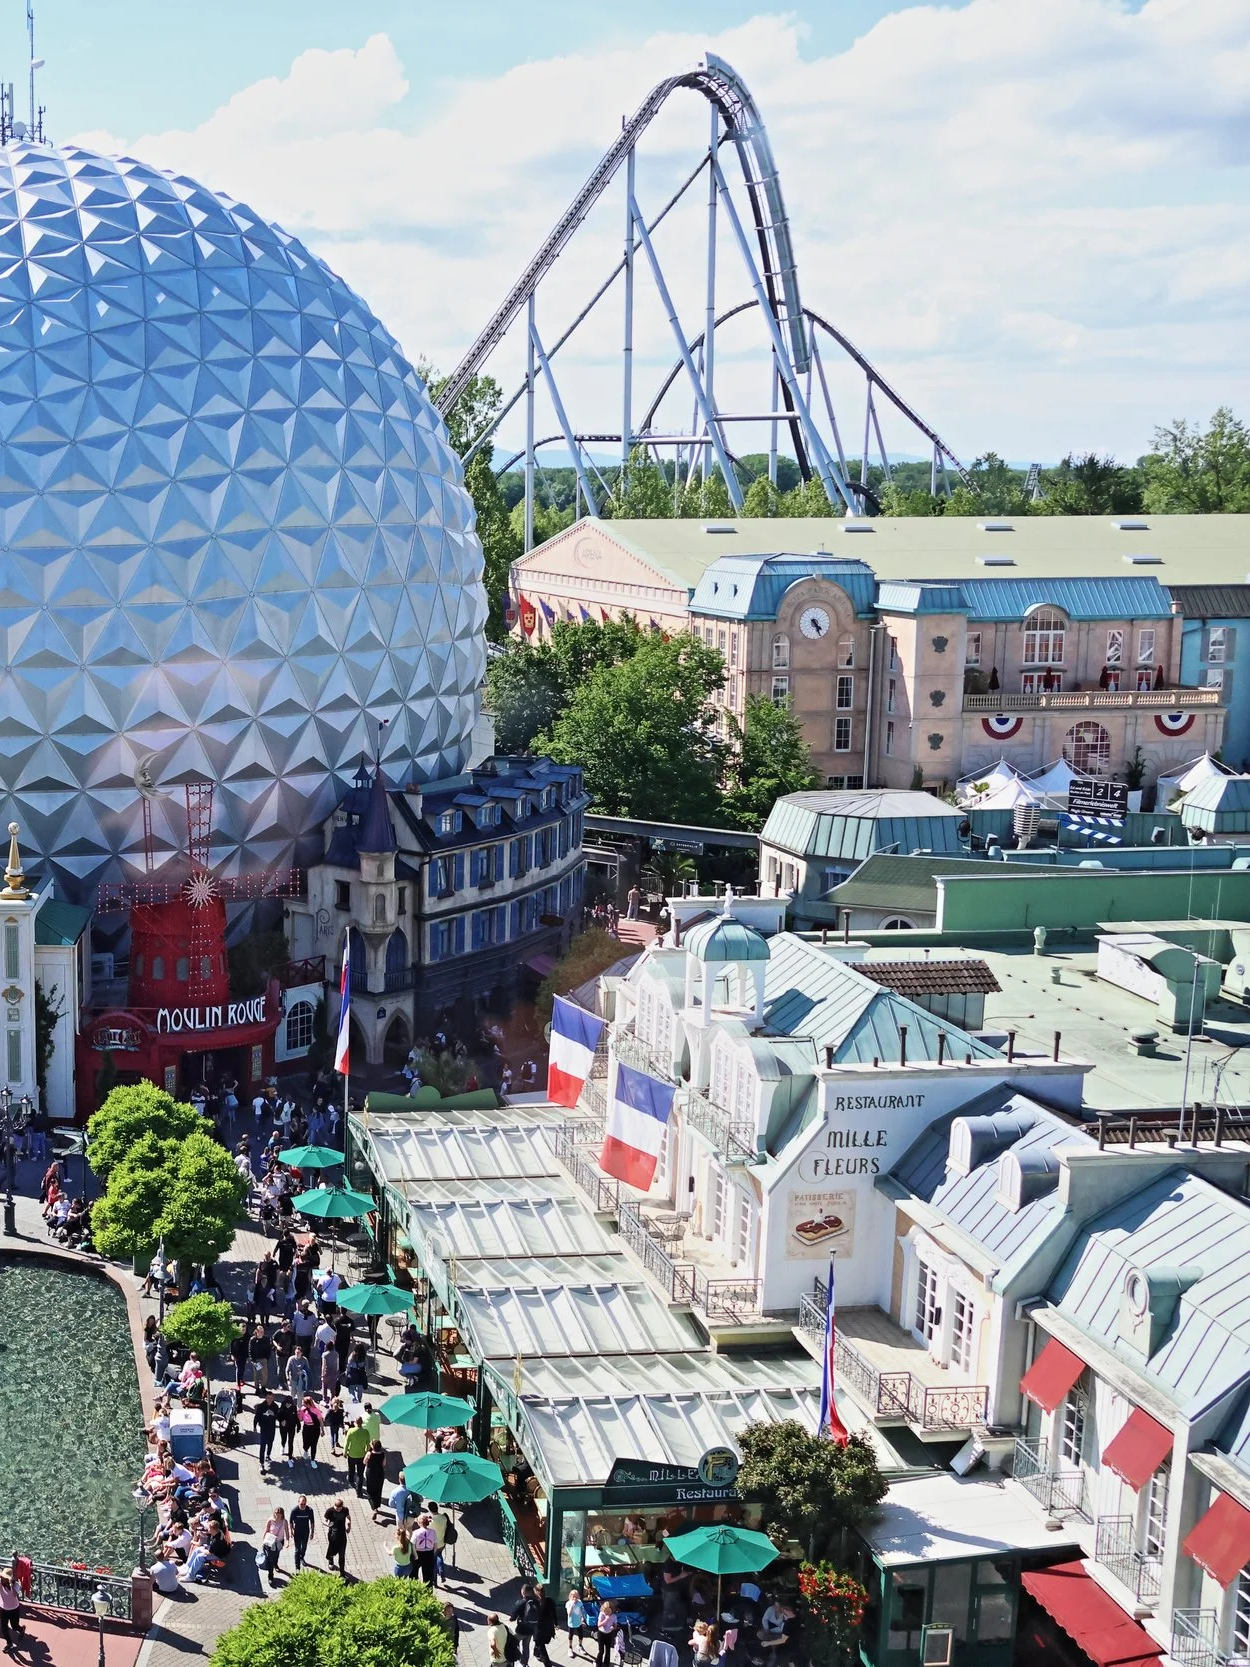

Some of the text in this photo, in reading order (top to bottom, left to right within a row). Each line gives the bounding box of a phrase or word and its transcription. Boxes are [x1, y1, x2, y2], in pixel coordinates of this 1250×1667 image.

[1096, 788, 1104, 796] 2
[1113, 790, 1121, 798] 4
[157, 996, 266, 1034] MOULIN ROUGE
[835, 1095, 925, 1111] RESTAURANT
[827, 1129, 887, 1148] MILLE
[813, 1157, 880, 1177] FLEURS
[649, 1468, 700, 1481] MILLE
[676, 1488, 737, 1499] Restaura
